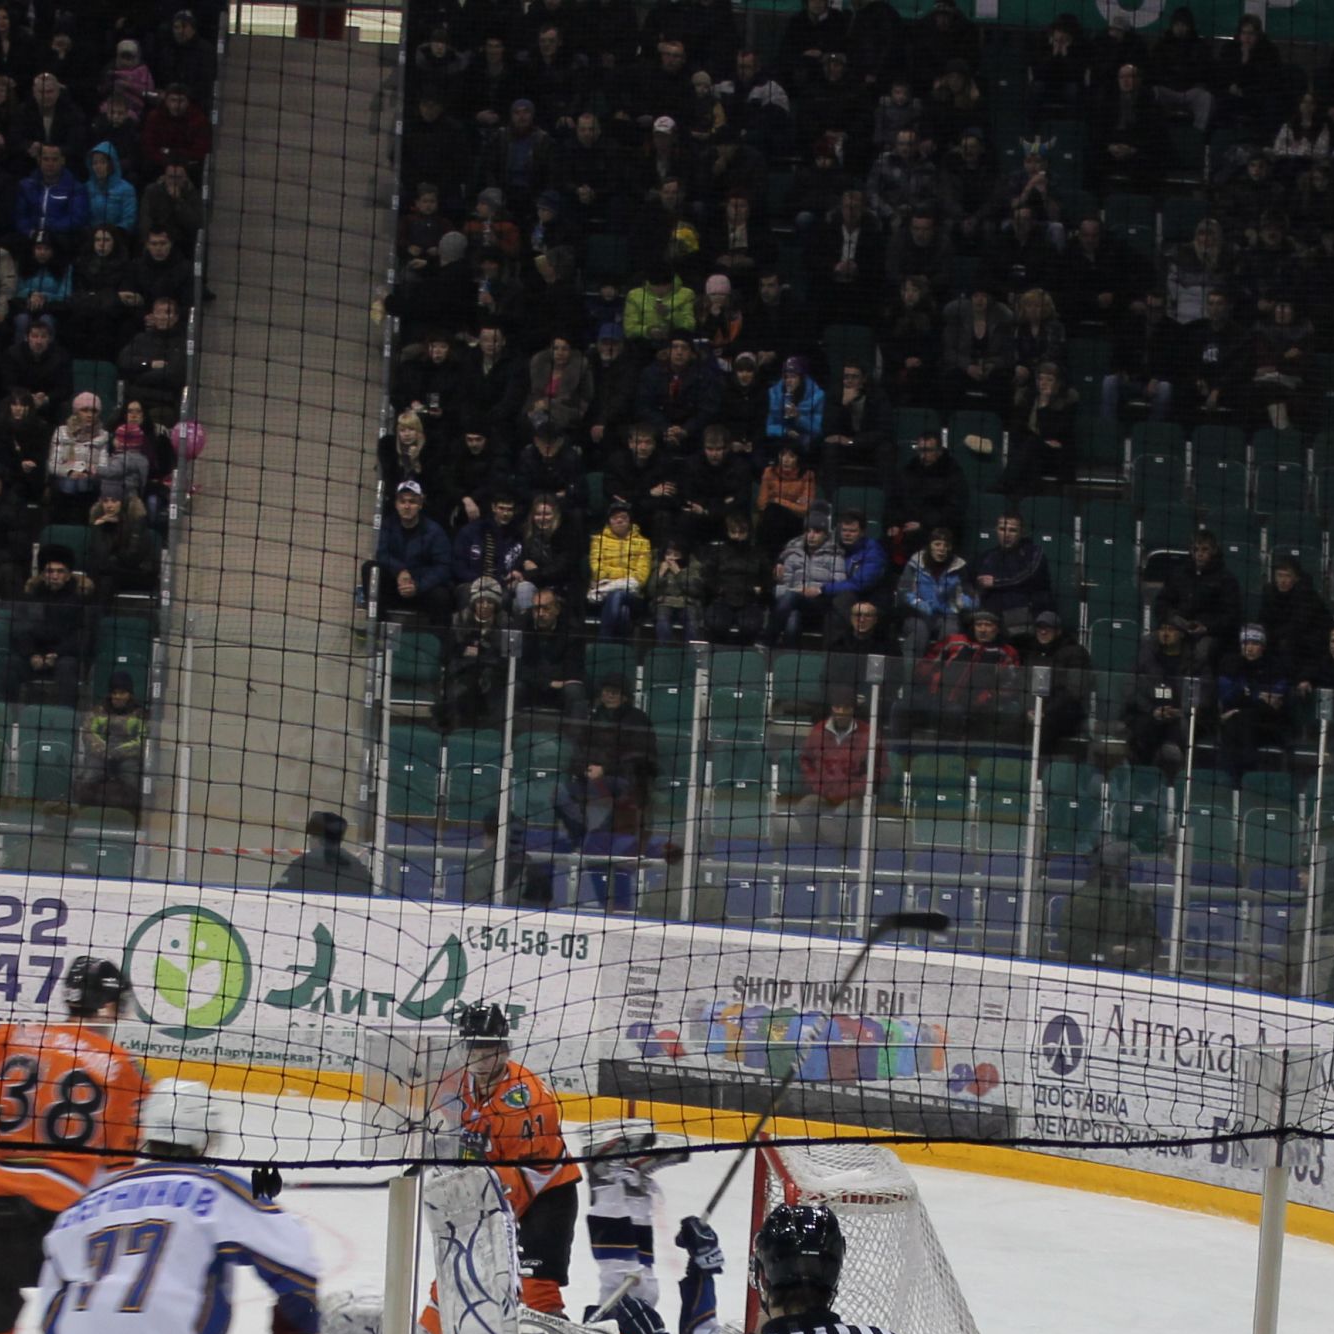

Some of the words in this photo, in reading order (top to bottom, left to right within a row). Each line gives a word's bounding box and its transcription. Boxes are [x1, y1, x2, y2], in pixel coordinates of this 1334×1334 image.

[1103, 1004, 1238, 1075] Аптека
[521, 1113, 545, 1140] 41
[1035, 1084, 1129, 1117] ДОСТАВКА
[73, 1218, 173, 1313] 77
